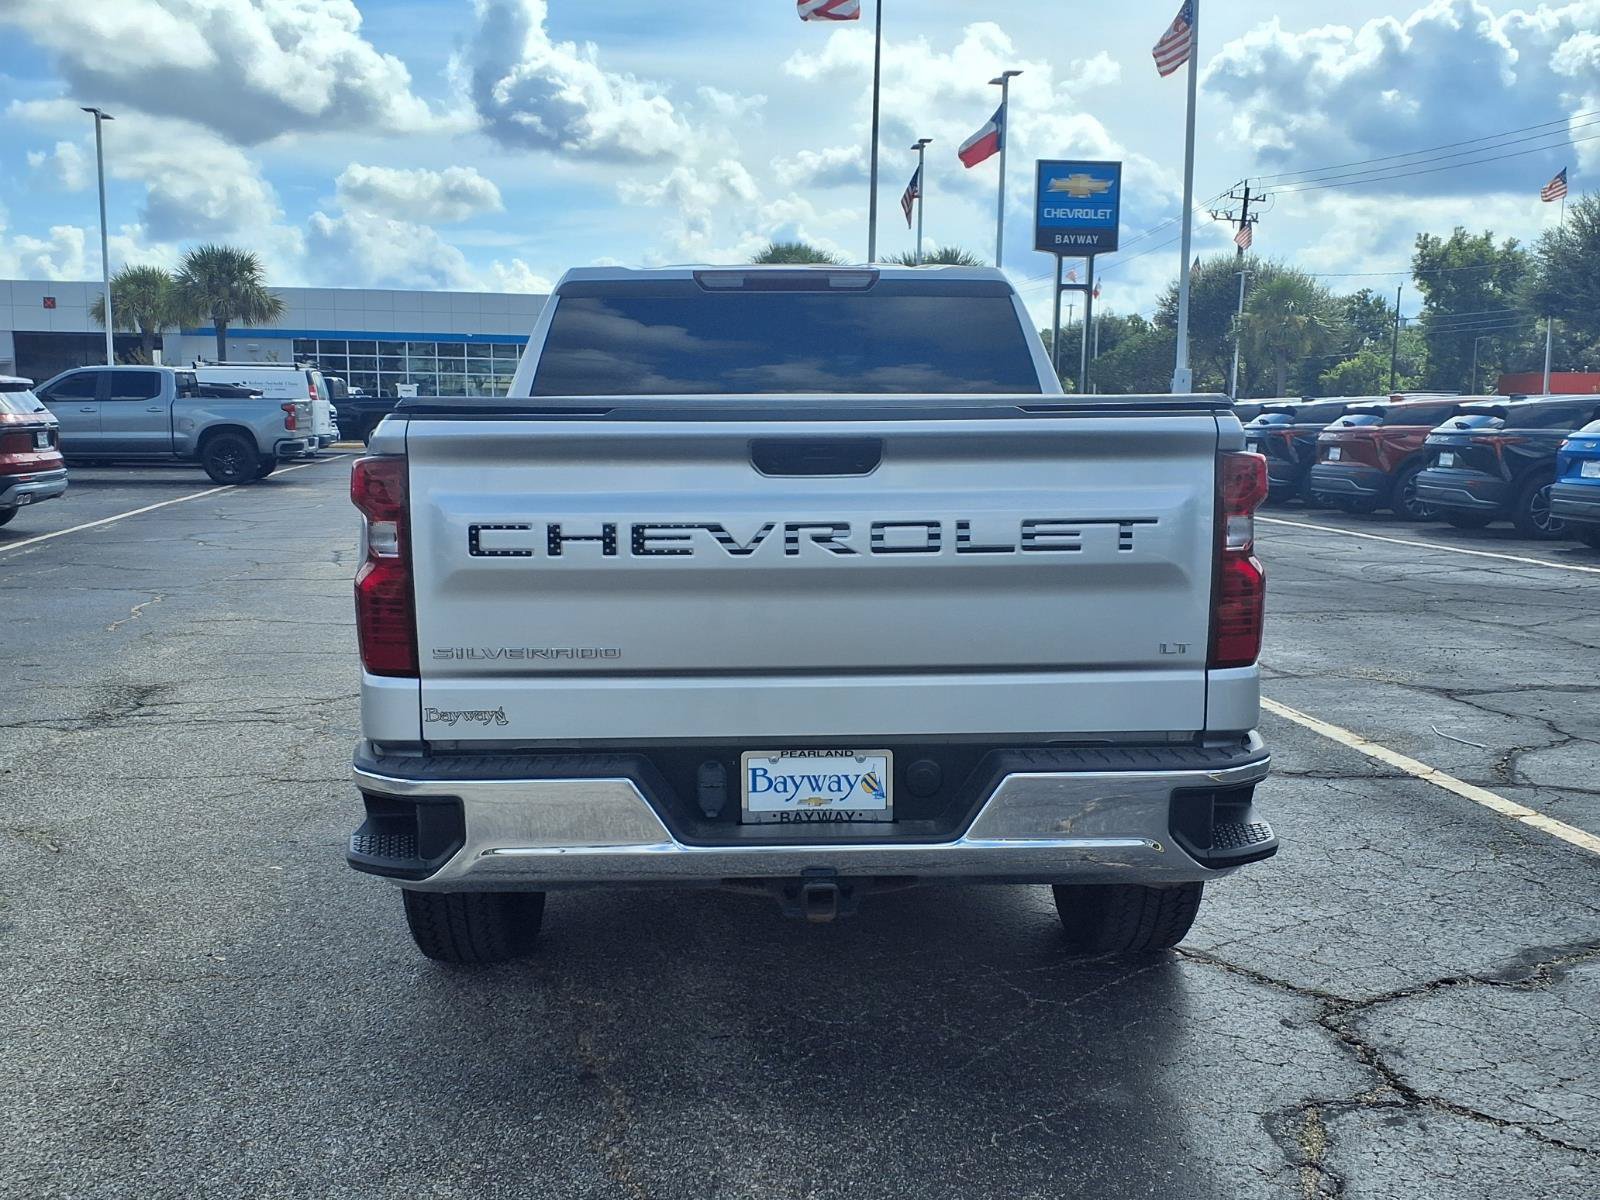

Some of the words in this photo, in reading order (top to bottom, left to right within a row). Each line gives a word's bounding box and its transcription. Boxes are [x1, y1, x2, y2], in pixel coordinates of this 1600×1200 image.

[1043, 207, 1112, 219] CHEVROLET
[1055, 234, 1099, 244] BAYWAY
[467, 515, 1159, 557] CHEVROLET
[432, 647, 622, 660] SILVERADO
[1159, 642, 1193, 655] LT
[424, 707, 501, 727] Bayway
[780, 750, 855, 758] PEARLAND
[749, 767, 861, 802] Bayway
[779, 811, 856, 823] BAYWAY
